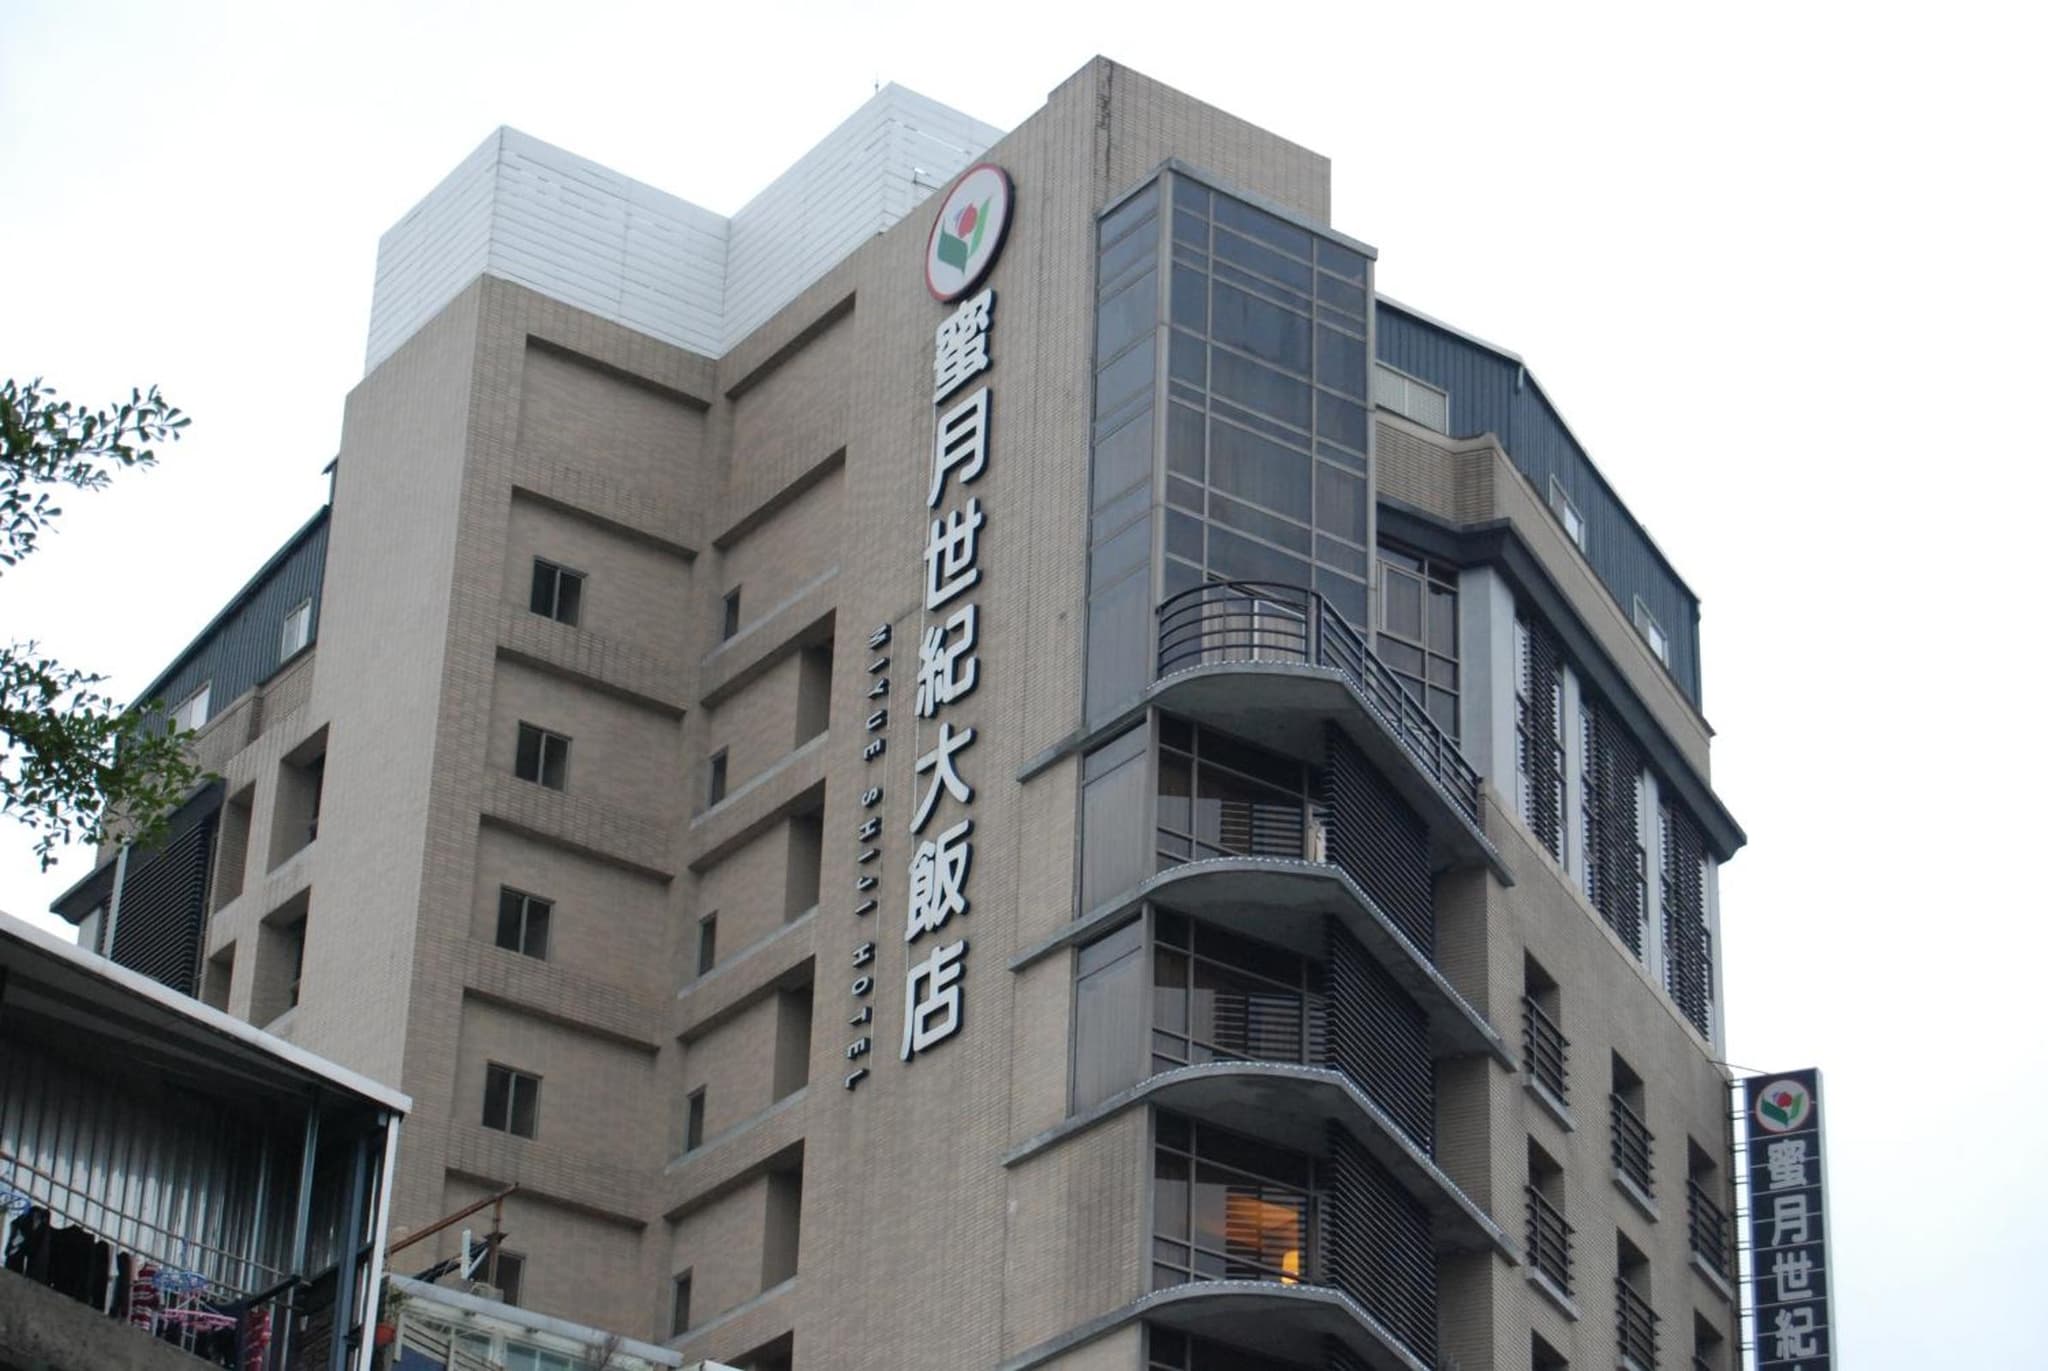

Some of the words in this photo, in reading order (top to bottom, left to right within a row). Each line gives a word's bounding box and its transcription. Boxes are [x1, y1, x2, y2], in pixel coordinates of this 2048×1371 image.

[901, 288, 993, 1062] 蜜月世紀大飯店
[856, 787, 882, 915] SHIJI
[845, 941, 875, 1091] HOTEL
[1767, 1138, 1816, 1371] 蜜月世紀
